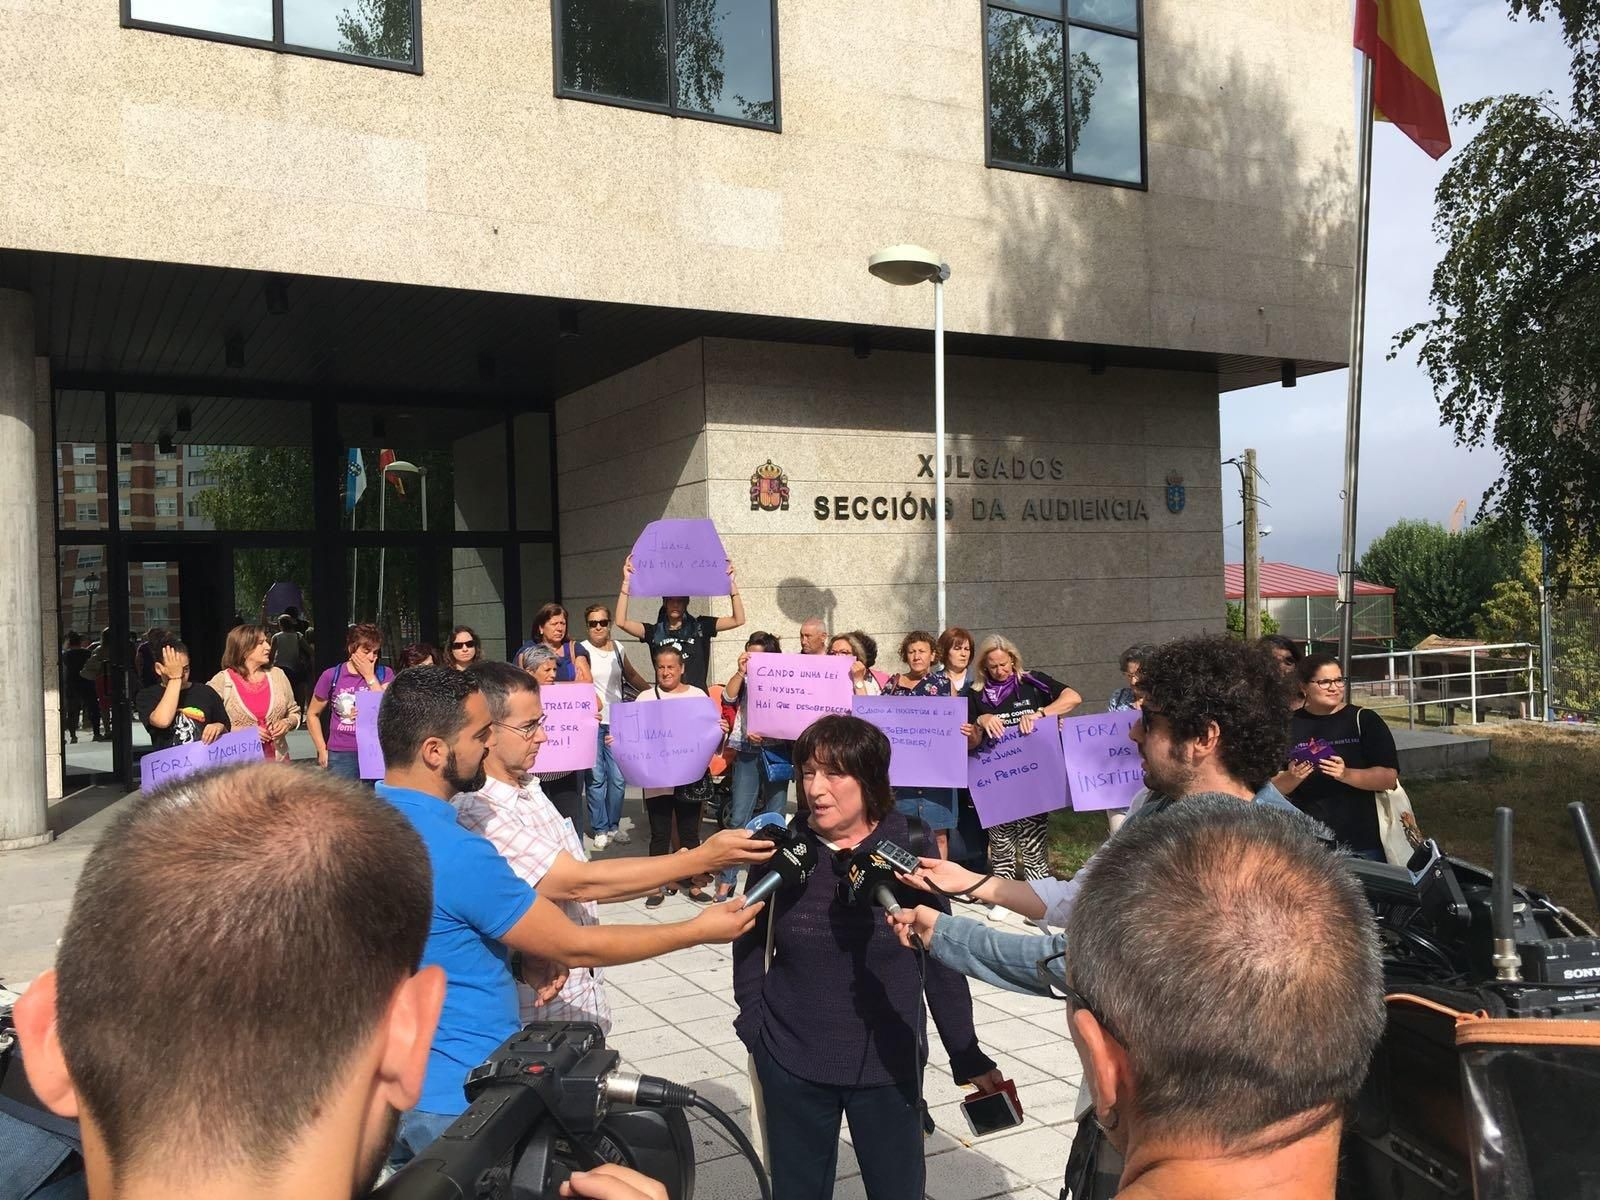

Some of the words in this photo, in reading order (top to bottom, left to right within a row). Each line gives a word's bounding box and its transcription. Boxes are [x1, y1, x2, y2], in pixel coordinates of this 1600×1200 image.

[917, 454, 1064, 480] XULGADOS
[814, 491, 953, 521] SECCIÓNS
[972, 498, 1006, 521] DA
[1022, 499, 1150, 522] AUDIENCIA
[756, 666, 795, 678] CANDO
[1011, 709, 1035, 717] CONTRA
[1076, 723, 1119, 743] FORA
[1108, 747, 1131, 757] DAS
[151, 756, 193, 780] FORA
[994, 763, 1039, 780] PERIGO
[1563, 967, 1600, 979] SONY
